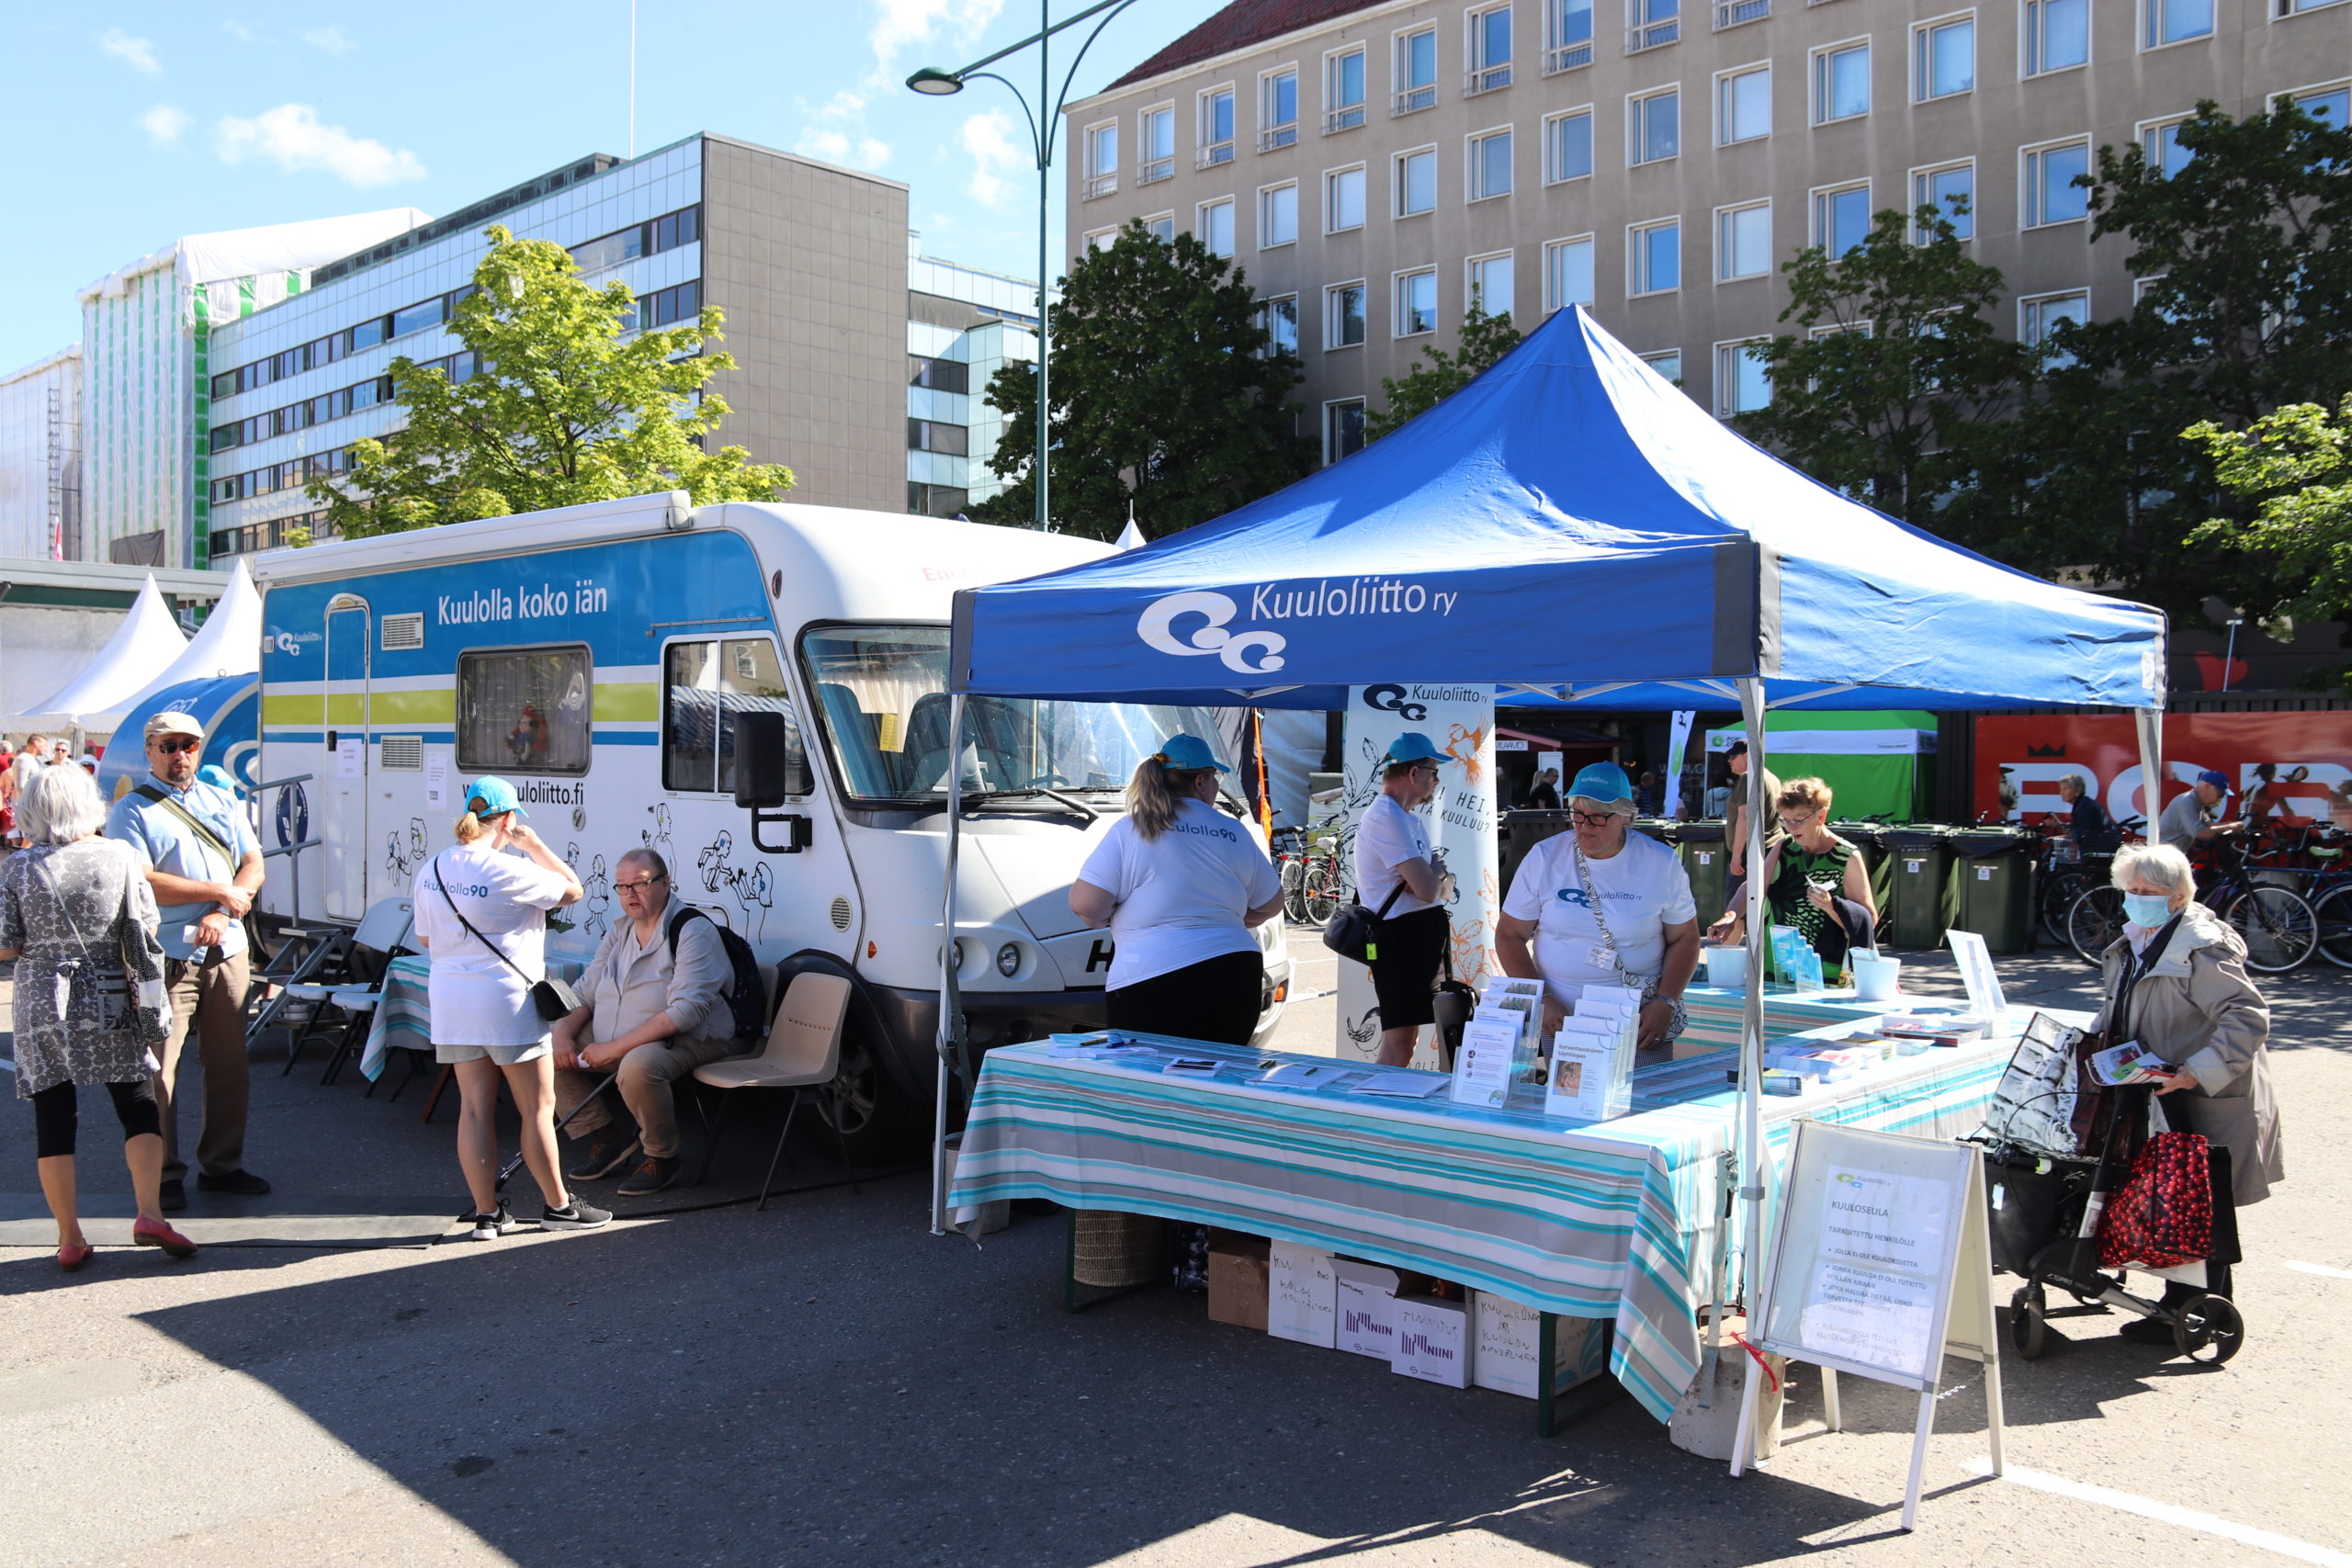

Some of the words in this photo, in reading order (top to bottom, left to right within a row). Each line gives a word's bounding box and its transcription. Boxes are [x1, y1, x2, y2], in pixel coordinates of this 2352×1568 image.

[438, 588, 513, 626] Kuulolla
[519, 582, 569, 619] koko
[575, 579, 608, 615] iän
[1251, 577, 1427, 621] Kuuloliitto
[1433, 592, 1458, 616] ry
[1412, 684, 1480, 703] Kuuloliitto
[1456, 792, 1490, 816] HEI,
[1440, 808, 1490, 834] KUULUU?
[423, 878, 489, 898] #kulolla90
[1558, 1043, 1604, 1055] Korvantauskojeen
[1831, 1201, 1889, 1218] KUULOSEULA
[1828, 1225, 1873, 1240] TARKOITETTU
[1874, 1234, 1916, 1247] HENKILÖLLE
[1834, 1248, 1851, 1257] JOLLA
[1859, 1252, 1871, 1260] OLE
[1871, 1255, 1918, 1268] KUULOKOJETTA
[1831, 1265, 1851, 1274] JONKA
[1852, 1269, 1877, 1280] KUULOA
[1878, 1273, 1884, 1281] EI
[1884, 1275, 1896, 1284] OLE
[1828, 1284, 1844, 1292] JOKA
[1894, 1298, 1913, 1307] ONKO
